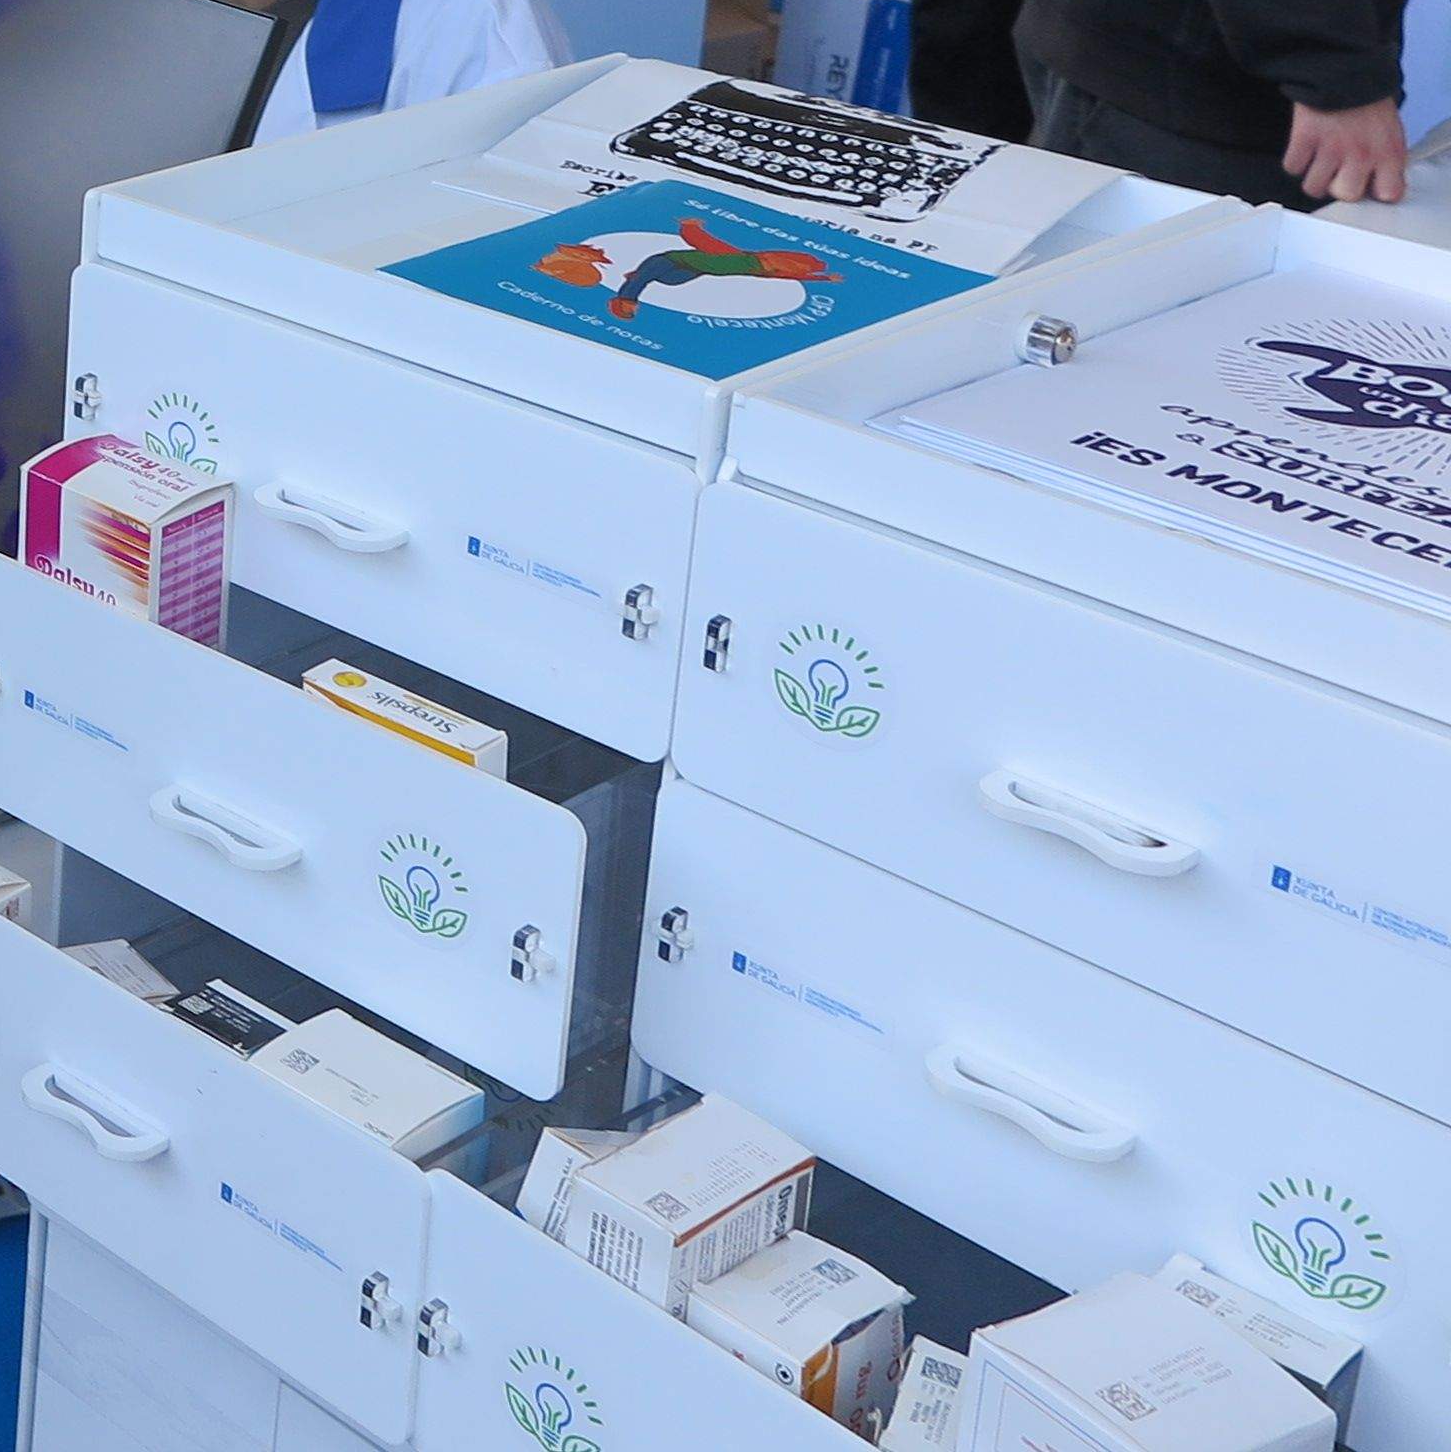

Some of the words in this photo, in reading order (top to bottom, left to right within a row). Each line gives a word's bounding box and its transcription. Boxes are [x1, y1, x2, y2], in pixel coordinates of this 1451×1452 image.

[710, 207, 759, 229] libre
[760, 226, 800, 243] das
[851, 256, 911, 280] ideas
[497, 279, 576, 316] Caderno
[577, 311, 604, 328] de
[605, 324, 666, 351] notas
[1317, 359, 1451, 406] BO
[99, 441, 157, 470] Dalsy
[157, 478, 189, 493] oral
[1165, 462, 1451, 569] MONTECE
[371, 690, 459, 734] Strepsils
[1310, 892, 1360, 919] GALICIA
